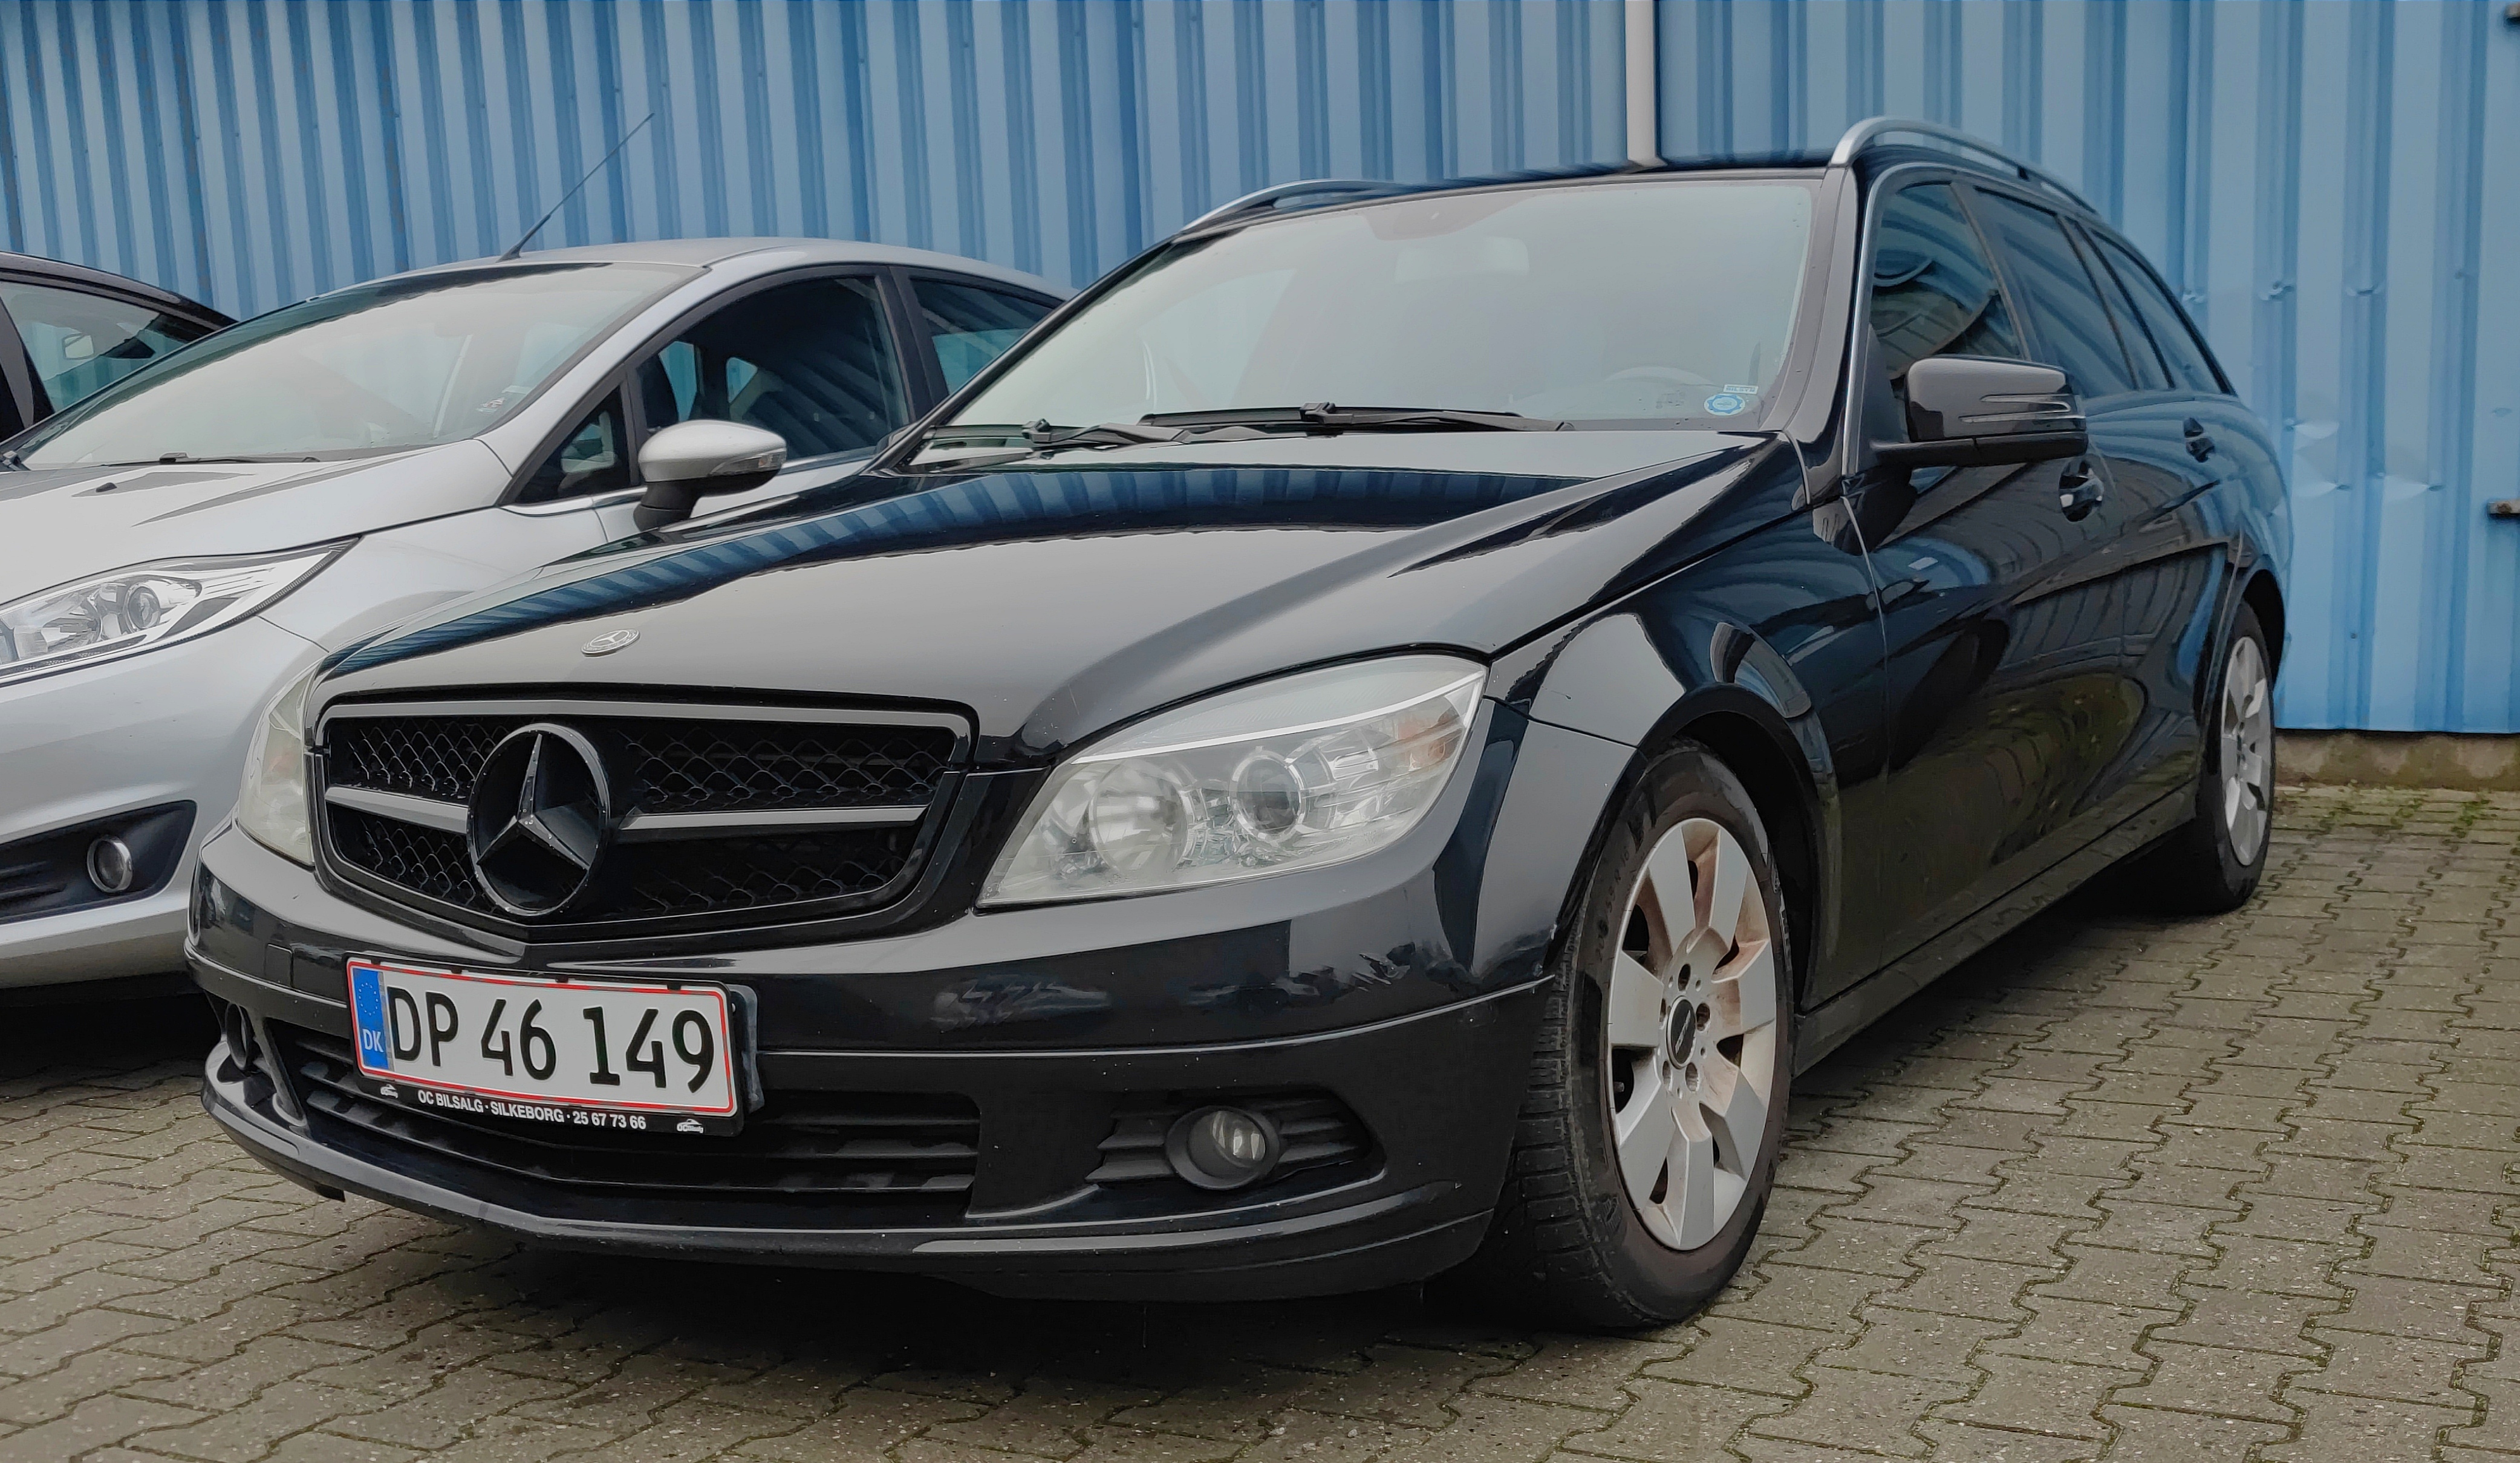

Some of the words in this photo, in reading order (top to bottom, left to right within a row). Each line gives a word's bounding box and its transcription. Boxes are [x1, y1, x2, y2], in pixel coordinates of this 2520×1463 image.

[362, 1028, 384, 1053] DK
[386, 986, 459, 1067] DP
[480, 998, 557, 1081] 46
[582, 1006, 715, 1093] 149
[417, 1089, 435, 1104] OC
[435, 1092, 484, 1113] BILSALG
[490, 1101, 565, 1123] SILKEBORG
[573, 1111, 589, 1125] 25
[591, 1112, 607, 1126] 67
[610, 1113, 627, 1129] 73
[630, 1115, 647, 1130] 66
